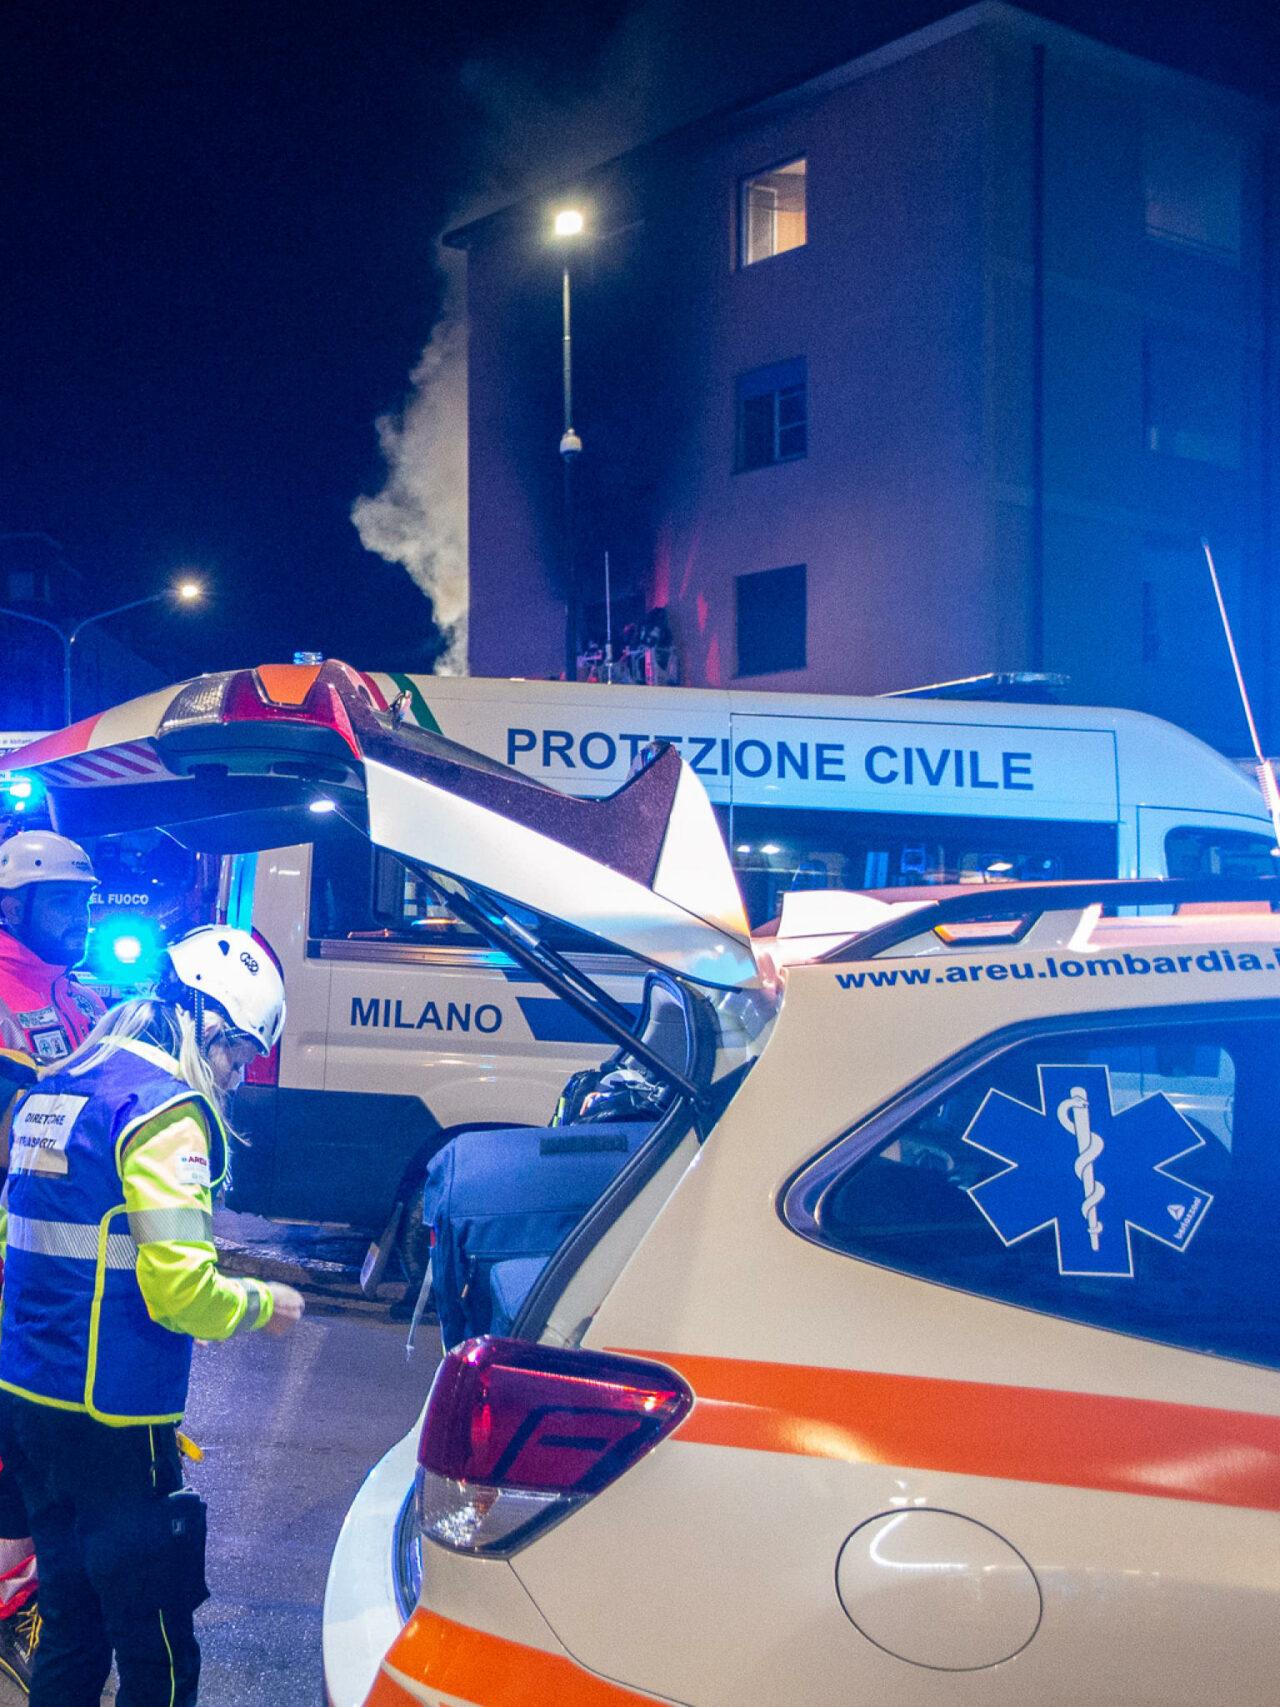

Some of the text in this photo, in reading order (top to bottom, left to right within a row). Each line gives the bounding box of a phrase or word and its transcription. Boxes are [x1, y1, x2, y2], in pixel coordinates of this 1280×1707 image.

[864, 745, 1034, 791] CIVILE
[108, 893, 150, 905] FUOCO
[350, 997, 503, 1034] MILANO
